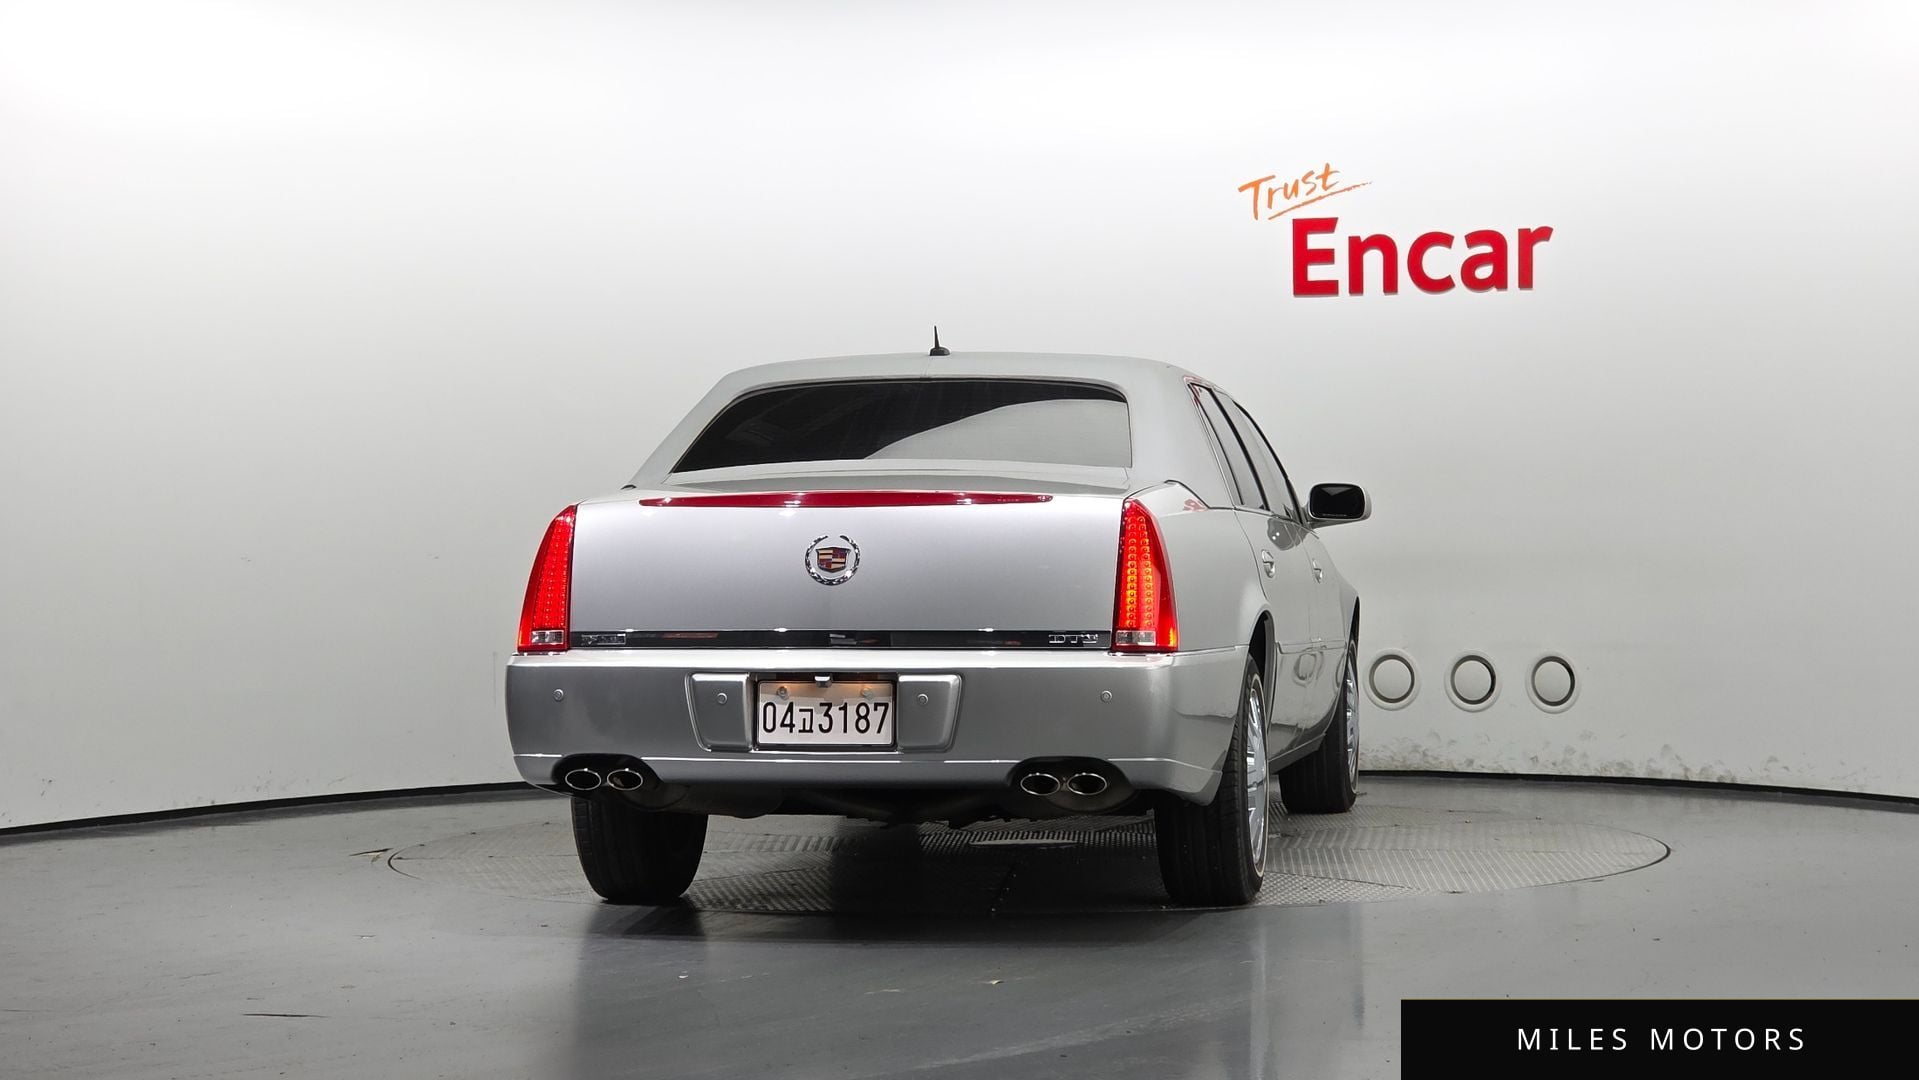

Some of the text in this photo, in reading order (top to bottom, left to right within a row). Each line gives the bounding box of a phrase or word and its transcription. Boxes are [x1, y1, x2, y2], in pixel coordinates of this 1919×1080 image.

[1238, 163, 1340, 220] Trust
[1292, 217, 1554, 297] Encar
[762, 701, 890, 734] 04고3187
